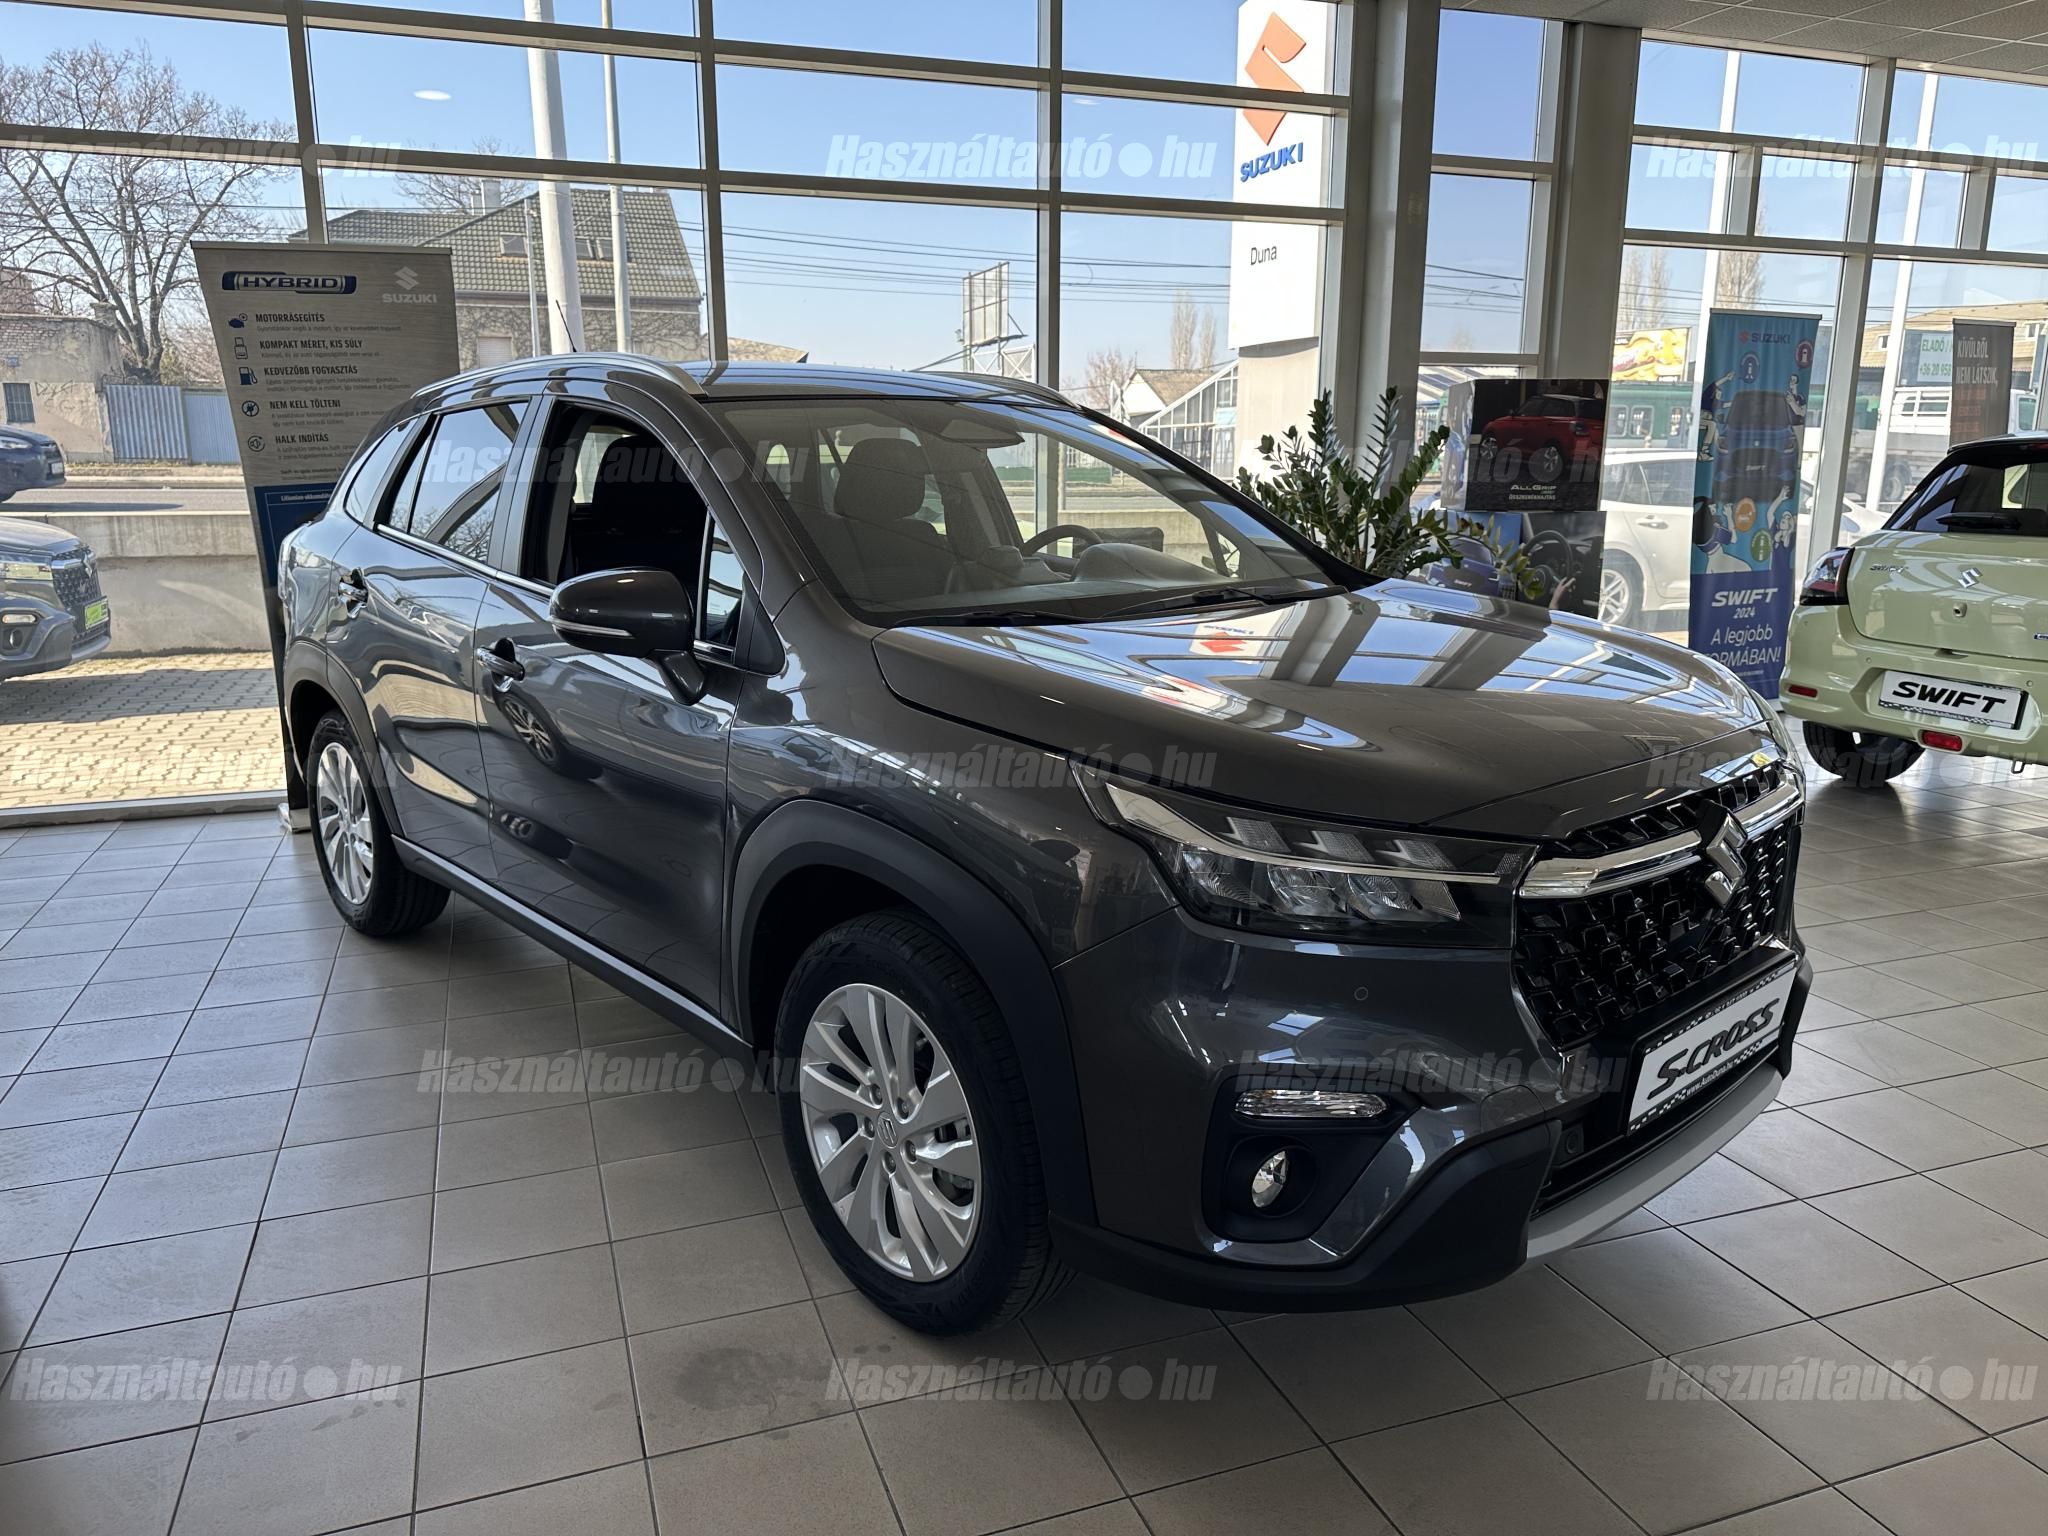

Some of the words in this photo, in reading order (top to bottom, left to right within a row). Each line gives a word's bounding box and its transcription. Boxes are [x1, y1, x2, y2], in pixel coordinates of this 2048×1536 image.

[1240, 142, 1303, 182] SUZUKI
[1250, 244, 1277, 265] Duna
[243, 276, 338, 290] HYBRID
[382, 293, 437, 303] SUZUKI
[256, 312, 325, 322] MOTORRÁSEGÍTÉS
[260, 340, 298, 349] KOMPAKT
[330, 340, 343, 348] KIS
[345, 339, 362, 348] SÚLY
[1751, 332, 1791, 344] SUZUKI
[270, 401, 287, 409] NEM
[290, 400, 308, 409] KELL
[275, 435, 296, 444] HALK
[299, 432, 329, 443] INDÍTÁS
[1711, 587, 1778, 607] SWIFT
[1733, 606, 1756, 619] 2024
[1710, 628, 1721, 646] A
[1724, 624, 1773, 646] legjobb
[1706, 646, 1782, 667] ORMÁBAN!
[1892, 681, 2007, 713] SWIFT
